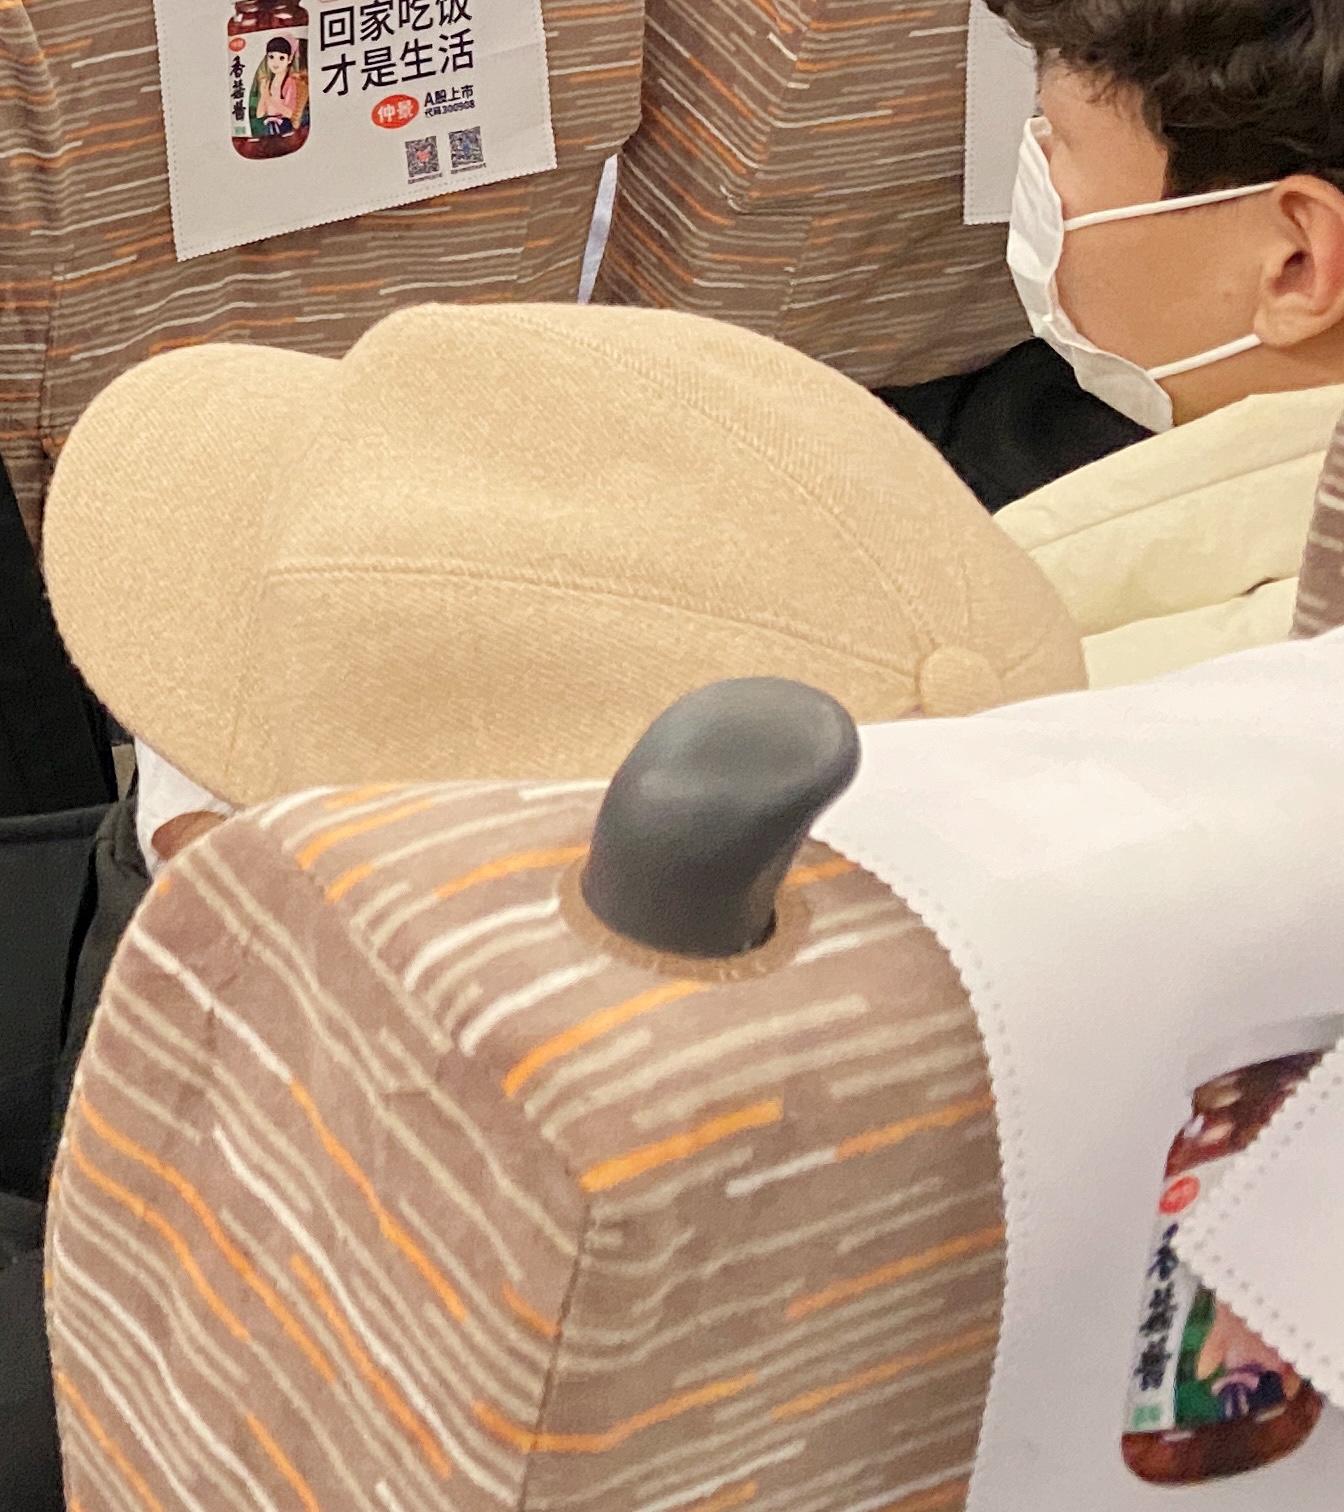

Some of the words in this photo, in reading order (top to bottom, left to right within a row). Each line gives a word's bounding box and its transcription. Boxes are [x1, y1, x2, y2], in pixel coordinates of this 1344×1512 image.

[321, 28, 474, 96] 才是生活
[424, 84, 474, 107] A股上市
